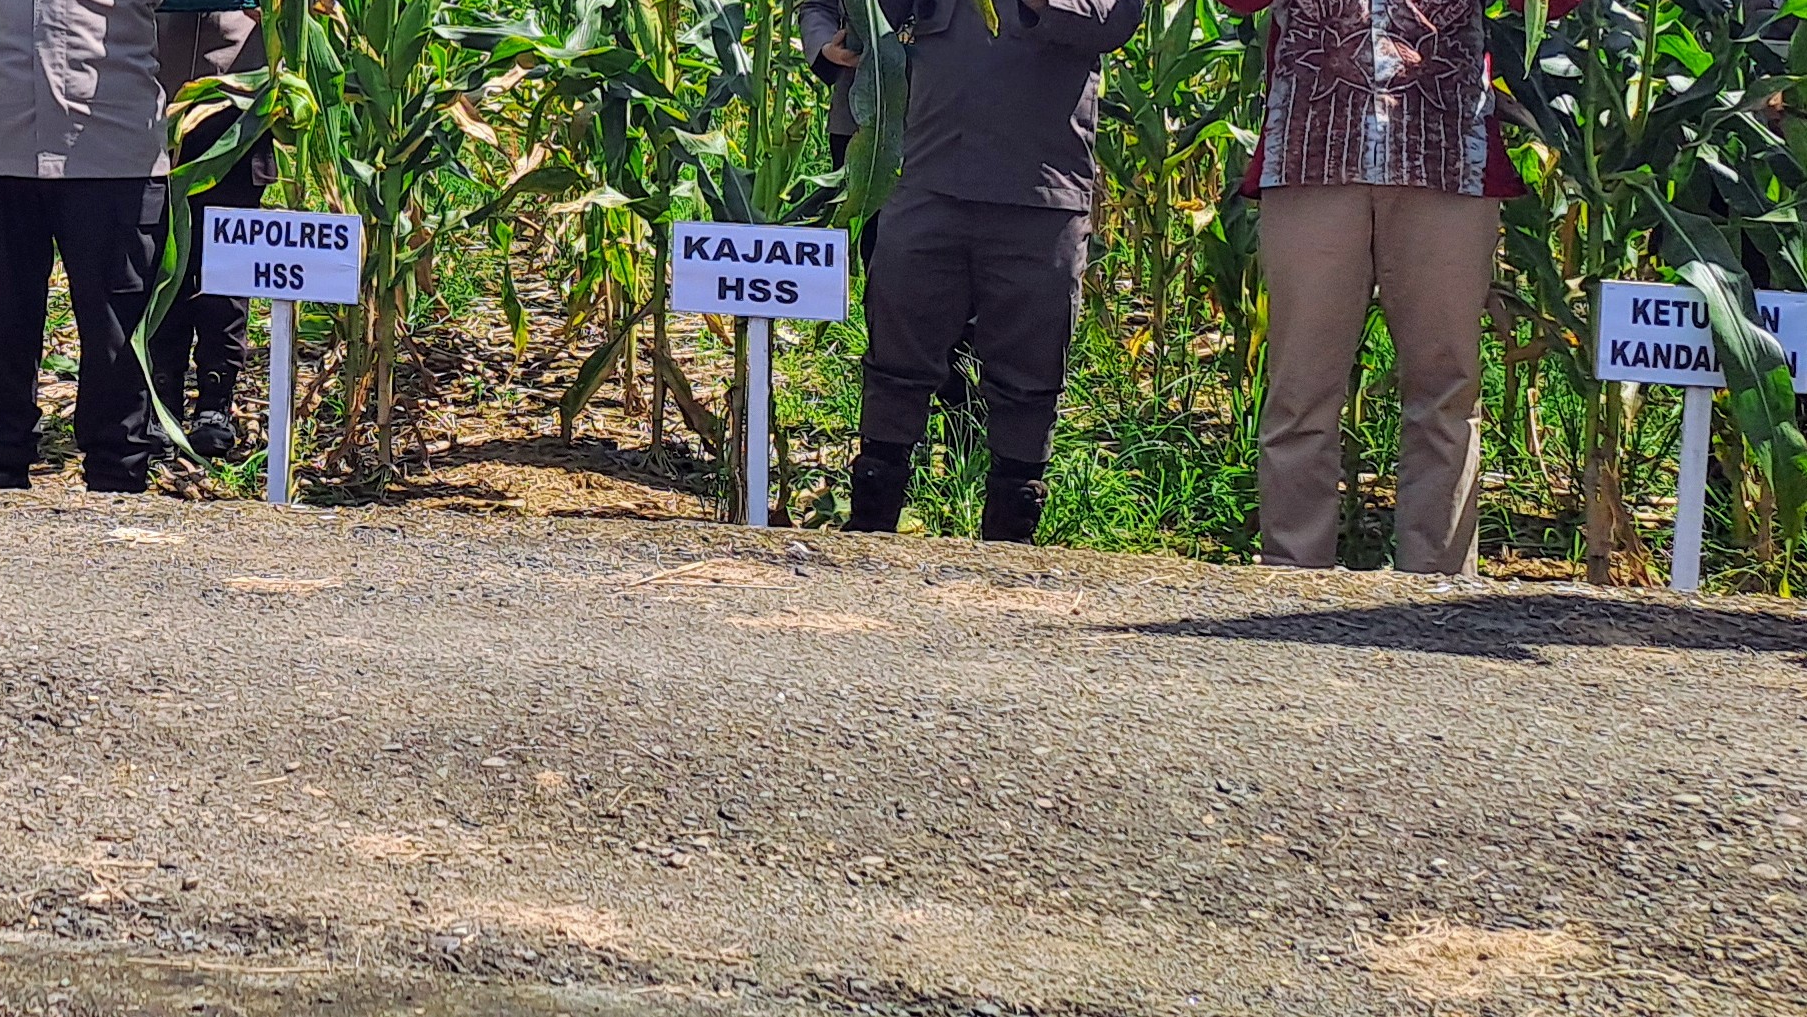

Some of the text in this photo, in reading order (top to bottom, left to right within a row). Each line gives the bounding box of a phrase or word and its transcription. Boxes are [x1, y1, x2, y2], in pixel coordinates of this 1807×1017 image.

[213, 217, 349, 250] KAPOLRES
[683, 235, 835, 267] KAJARI
[254, 262, 304, 290] HSS
[717, 276, 799, 304] HSS
[1631, 297, 1711, 329] KETU
